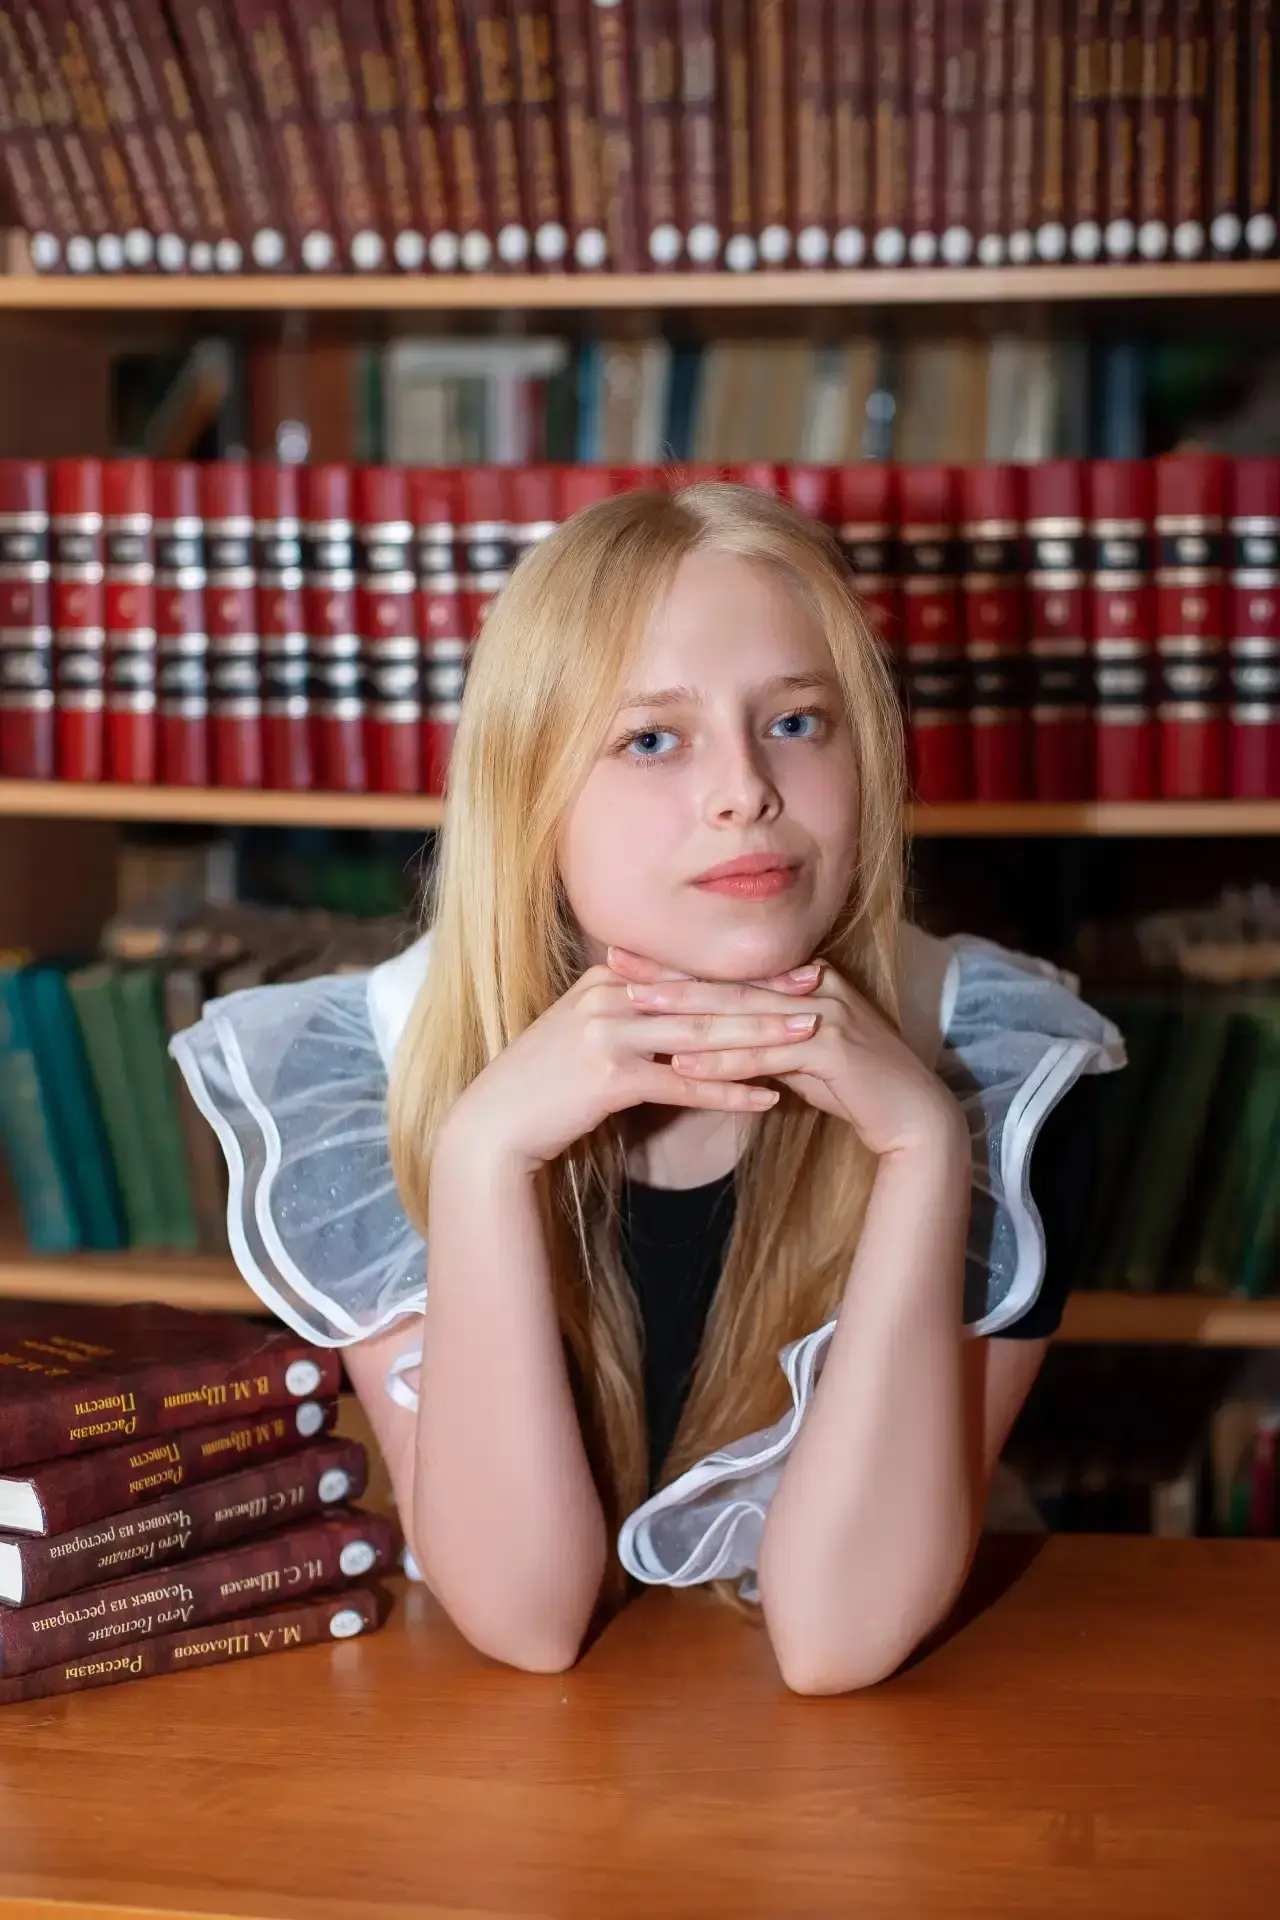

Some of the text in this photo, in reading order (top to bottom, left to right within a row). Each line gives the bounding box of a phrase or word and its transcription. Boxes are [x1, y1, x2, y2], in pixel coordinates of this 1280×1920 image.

[75, 1392, 136, 1414] Повести
[164, 1376, 269, 1407] В. М. Шукшин
[70, 1416, 136, 1440] Рассказы
[130, 1443, 180, 1467] Повести
[130, 1465, 182, 1492] Рассказы
[215, 1496, 268, 1522] Шмелев
[50, 1510, 191, 1558] Человек из ресторана
[98, 1531, 191, 1568] Лето Господне
[220, 1560, 322, 1596] И. С. Шмелев
[32, 1584, 194, 1632] Человек из ресторана
[88, 1604, 193, 1642] Лето Господне
[174, 1624, 301, 1658] М. А. Шолохов
[65, 1655, 142, 1680] Рассказы
